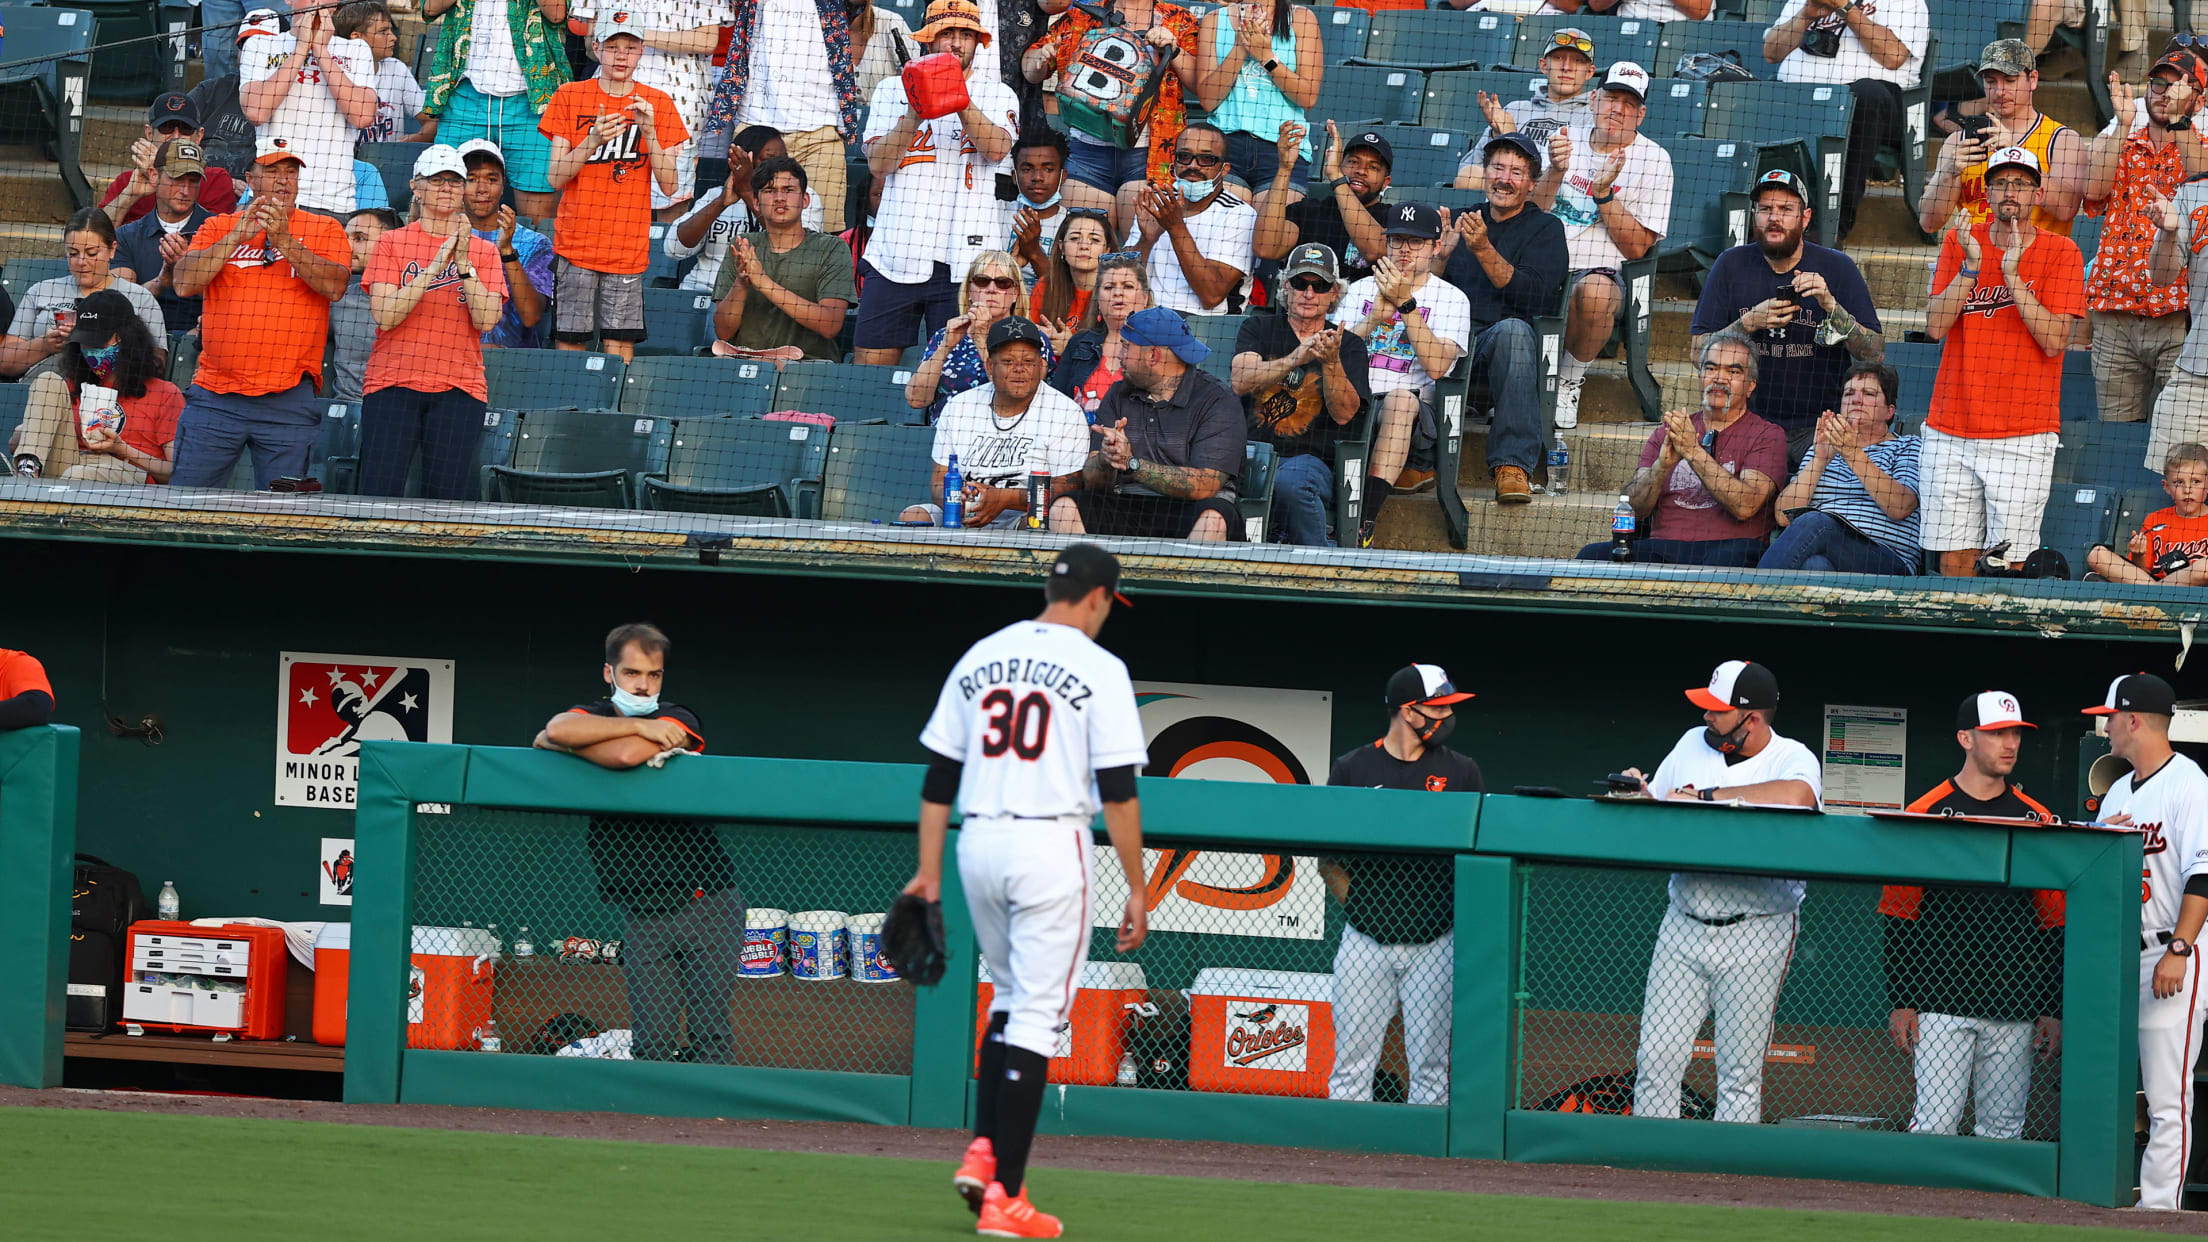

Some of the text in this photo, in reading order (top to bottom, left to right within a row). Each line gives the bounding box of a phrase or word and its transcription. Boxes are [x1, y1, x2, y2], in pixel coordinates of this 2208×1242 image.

[1072, 36, 1139, 101] B
[219, 114, 248, 134] PINK
[961, 435, 1034, 468] NIKE
[959, 658, 1093, 711] RODRIGUEZ
[981, 688, 1052, 763] 30
[285, 761, 345, 782] MINOR
[306, 785, 356, 803] BASE
[1278, 915, 1300, 928] TM
[743, 943, 773, 953] UBBLE
[798, 934, 812, 943] 300
[740, 951, 775, 962] BUBBLE
[1227, 1021, 1305, 1058] Orioles
